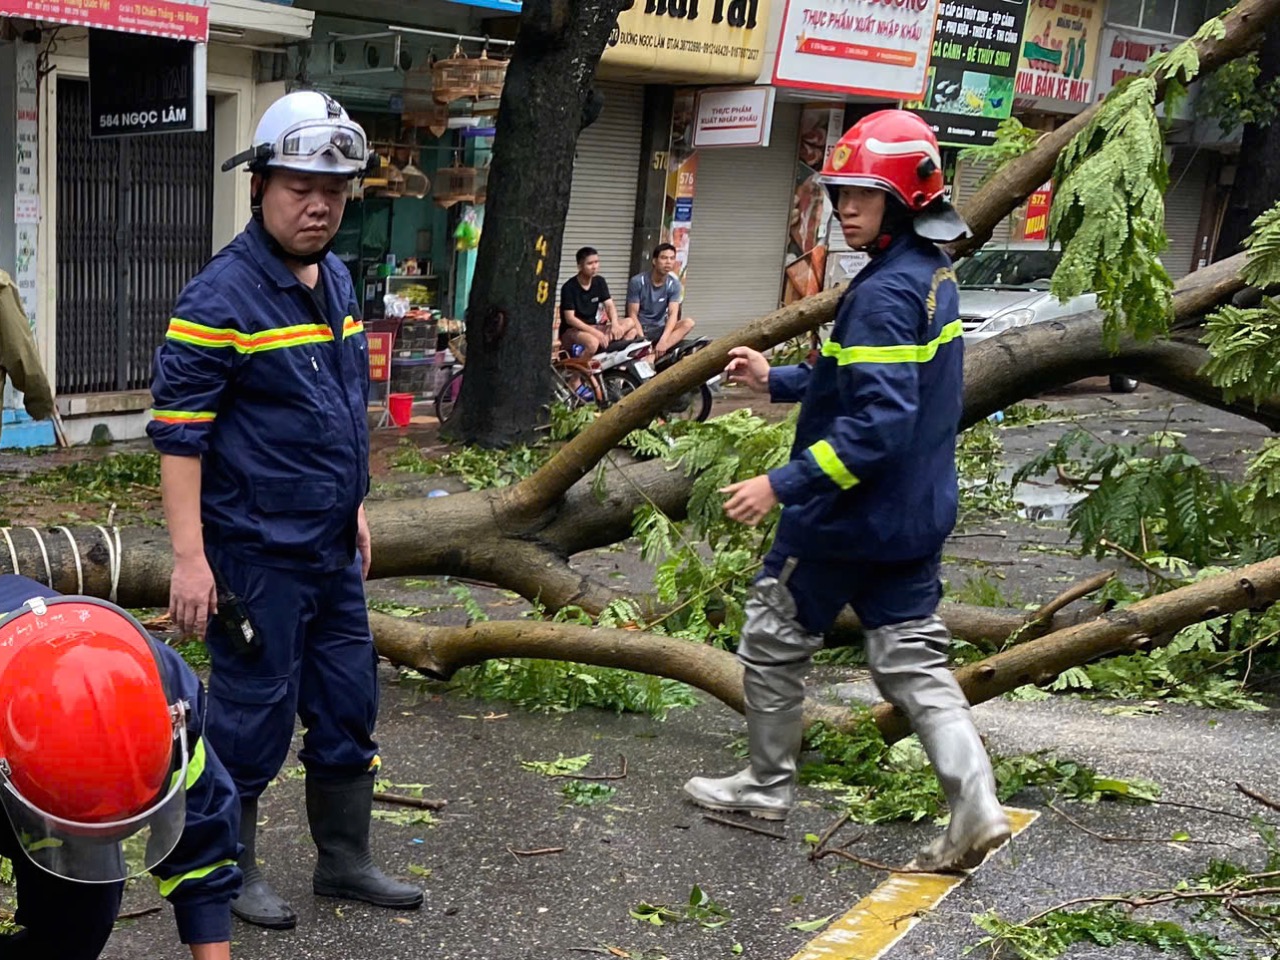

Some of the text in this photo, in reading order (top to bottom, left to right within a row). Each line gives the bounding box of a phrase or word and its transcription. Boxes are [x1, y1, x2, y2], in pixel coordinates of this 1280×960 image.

[803, 9, 827, 30] THỰC
[854, 13, 876, 33] XUẤT
[1056, 78, 1068, 99] XE
[100, 105, 186, 128] 584 NGỌC LÂM
[680, 172, 694, 184] 576
[1032, 194, 1046, 205] 572
[1026, 214, 1046, 235] MUA
